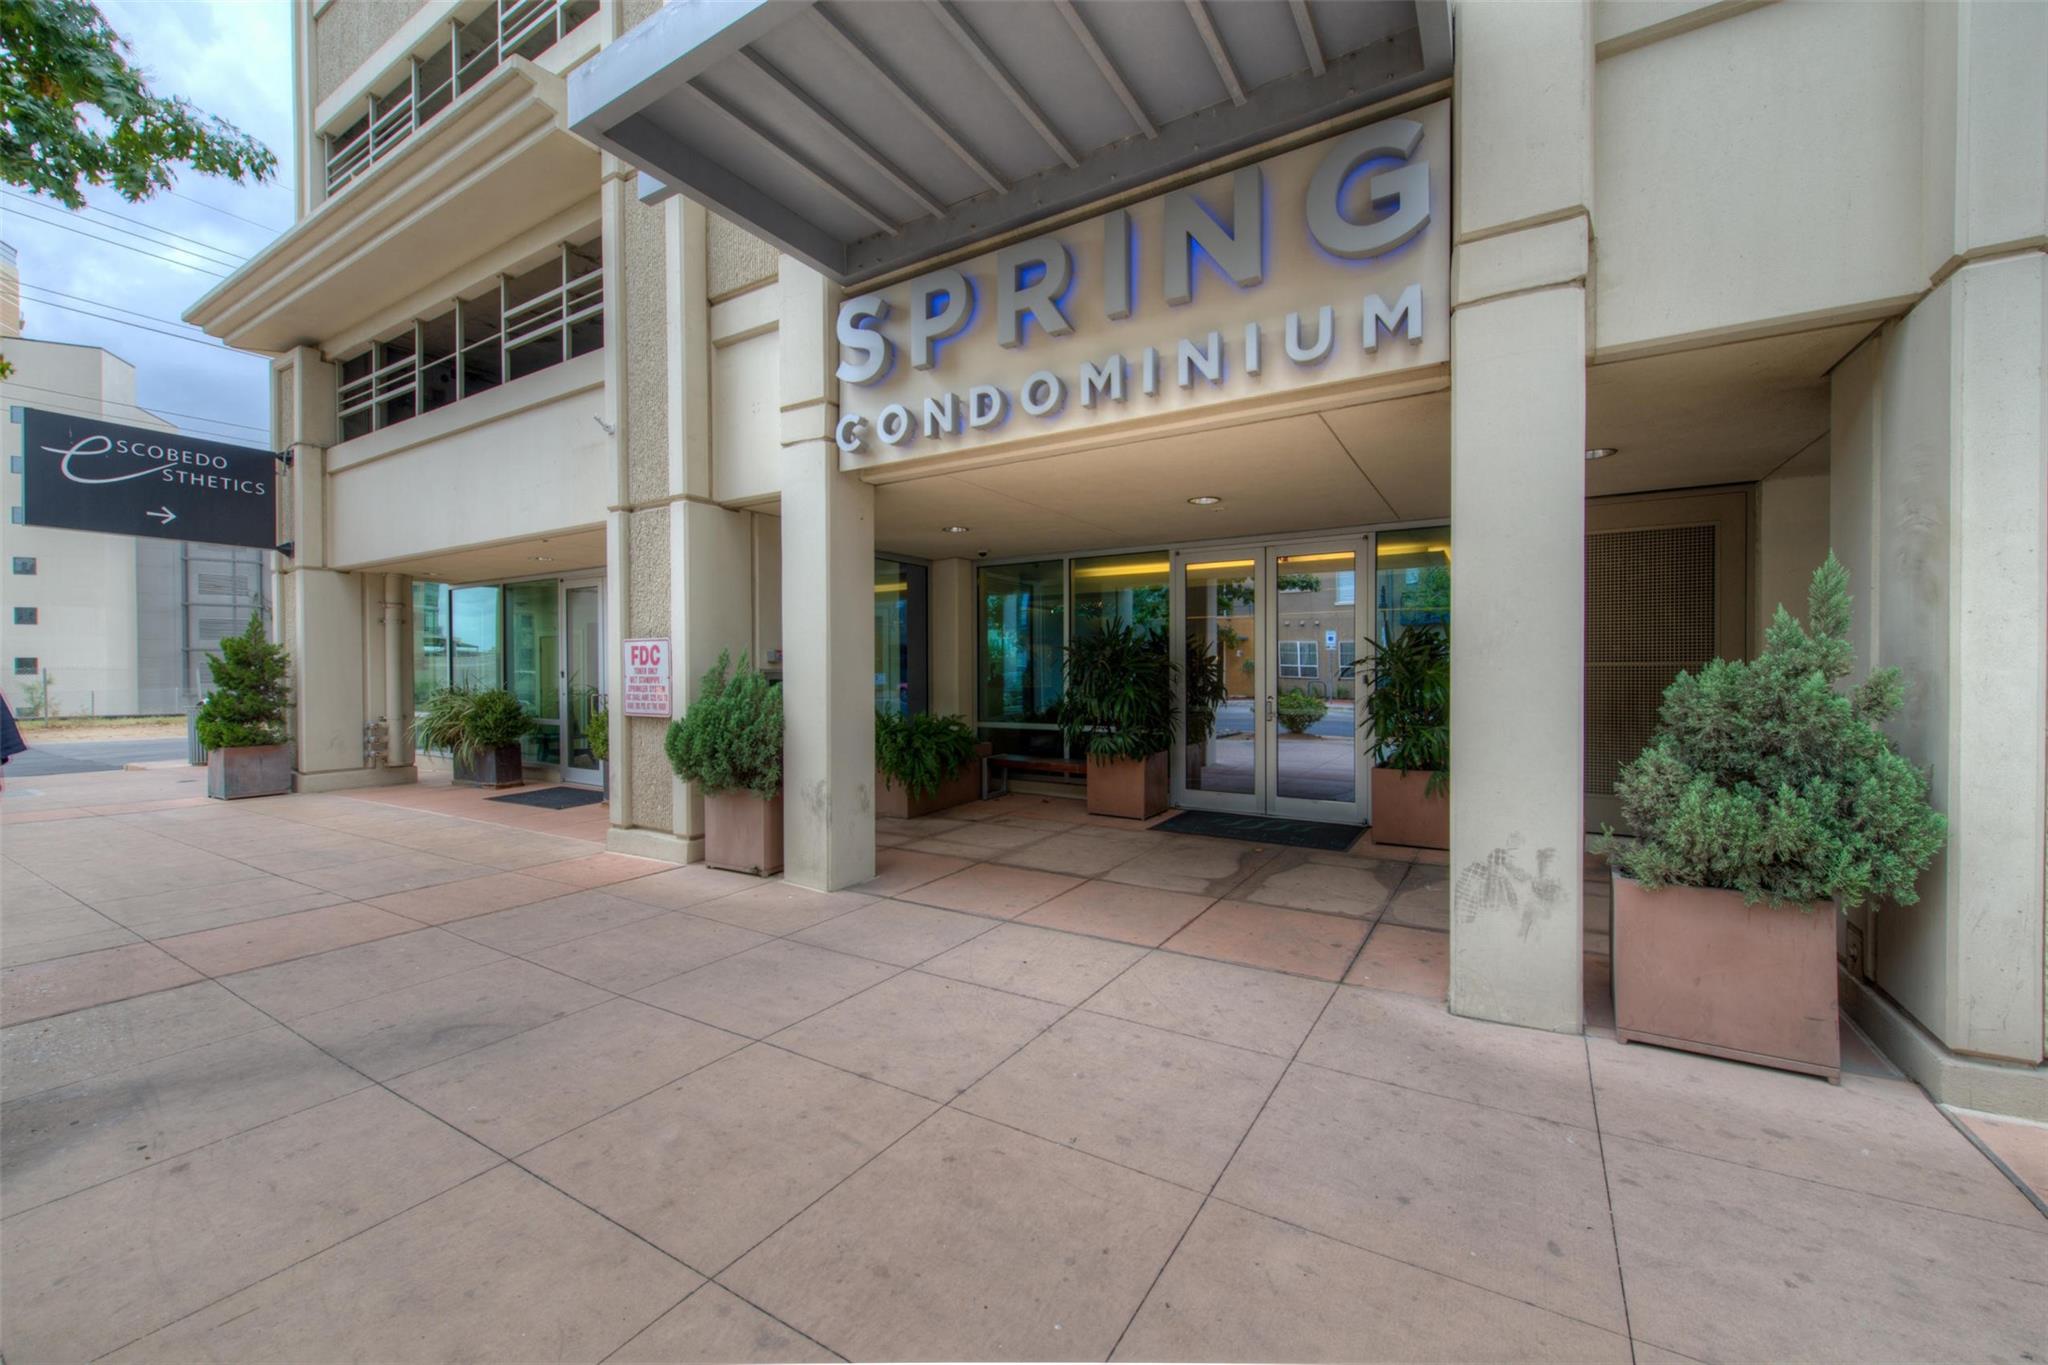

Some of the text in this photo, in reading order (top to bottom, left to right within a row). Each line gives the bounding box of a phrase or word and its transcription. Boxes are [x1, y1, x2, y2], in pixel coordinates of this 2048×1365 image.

[835, 117, 1432, 387] SPRING
[835, 283, 1424, 454] CONDOMINIUM
[631, 645, 661, 666] FDC
